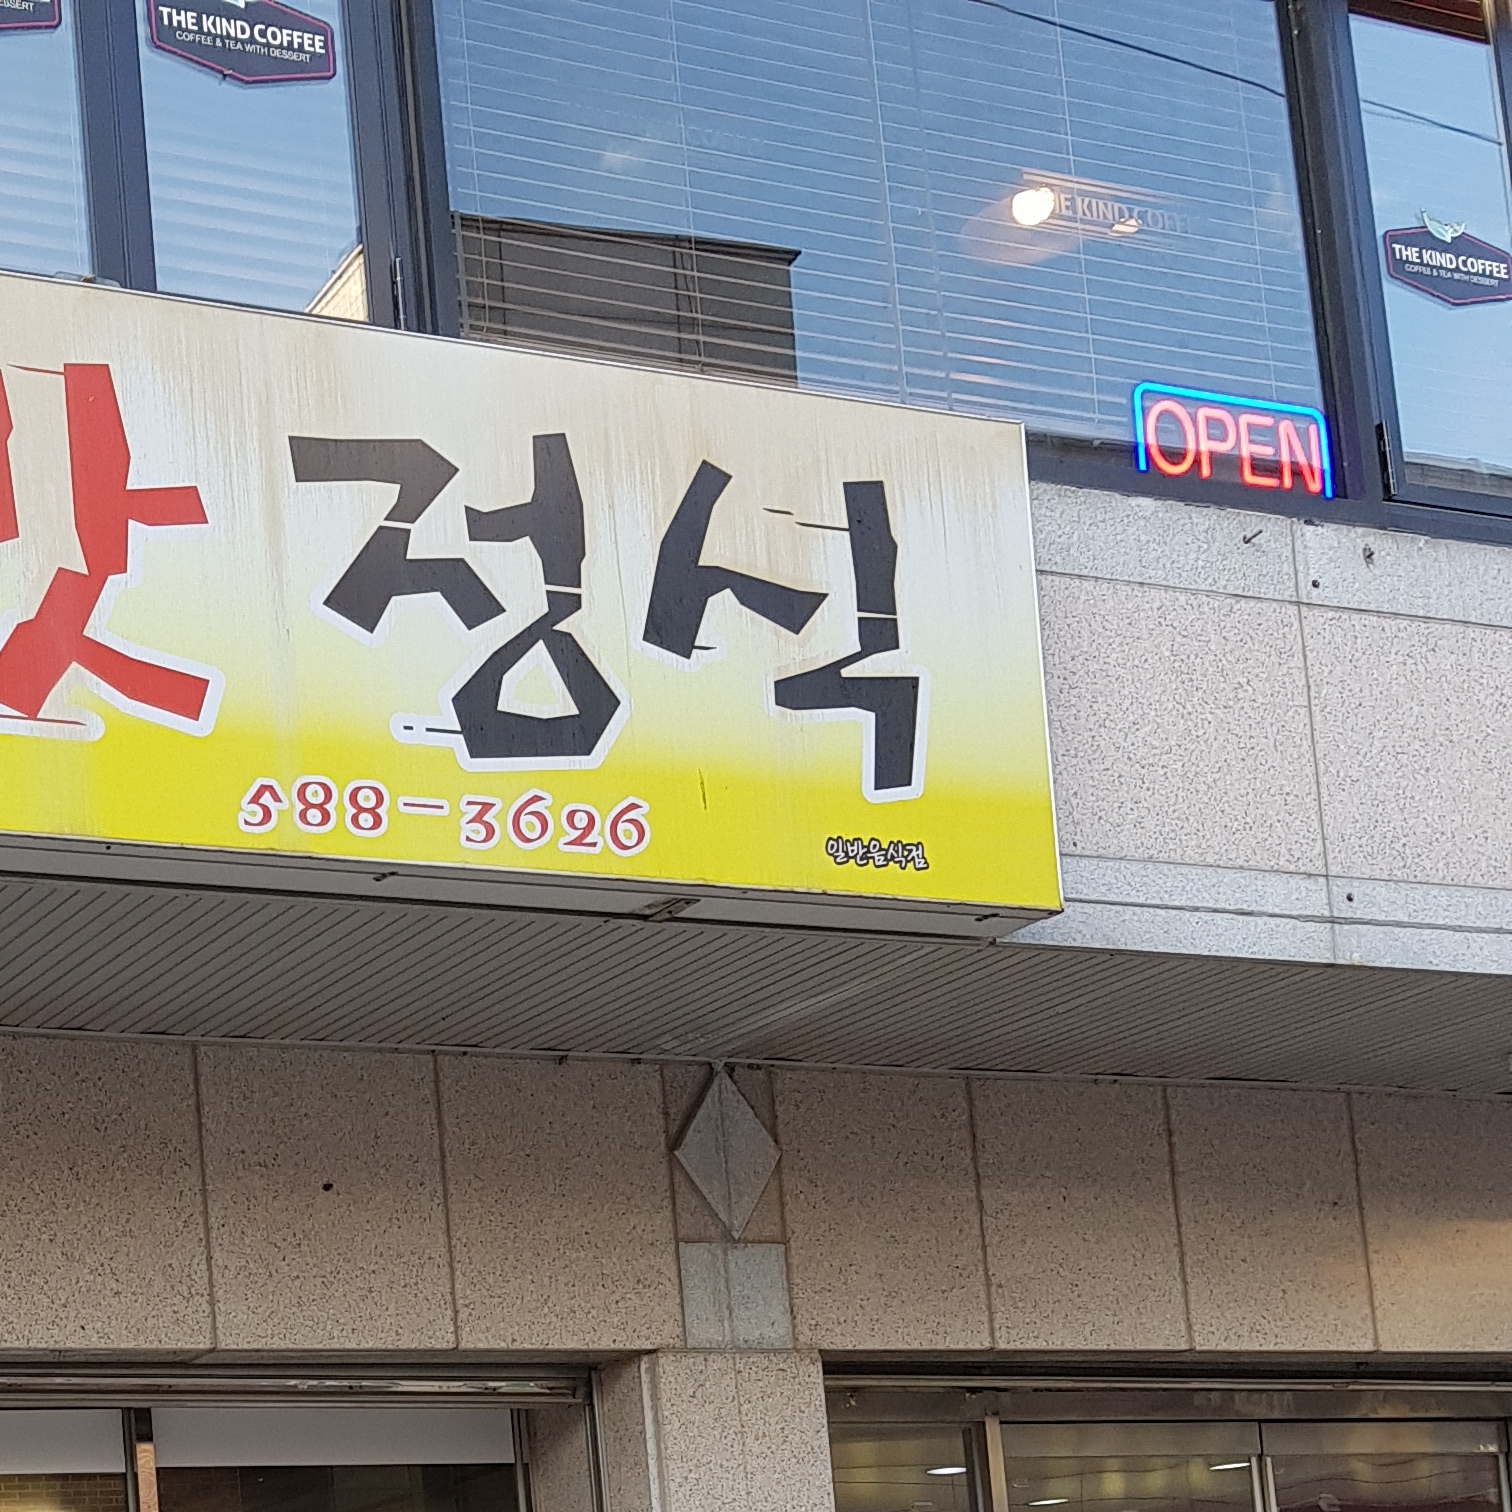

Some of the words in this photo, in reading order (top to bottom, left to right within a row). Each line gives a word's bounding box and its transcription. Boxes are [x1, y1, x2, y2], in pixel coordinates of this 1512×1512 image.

[158, 6, 198, 30] THE
[202, 13, 251, 39] KIND
[254, 24, 326, 53] COFFEE
[175, 31, 213, 46] COFFEE
[224, 39, 244, 51] TEA
[244, 43, 269, 56] WITH
[269, 48, 311, 63] DESSERT
[1391, 244, 1421, 262] THE
[1422, 249, 1457, 269] KIND
[1458, 256, 1510, 279] COFFEE
[1146, 399, 1324, 495] OPEN
[238, 775, 652, 857] 588-3626
[826, 836, 929, 870] 일반음식점
